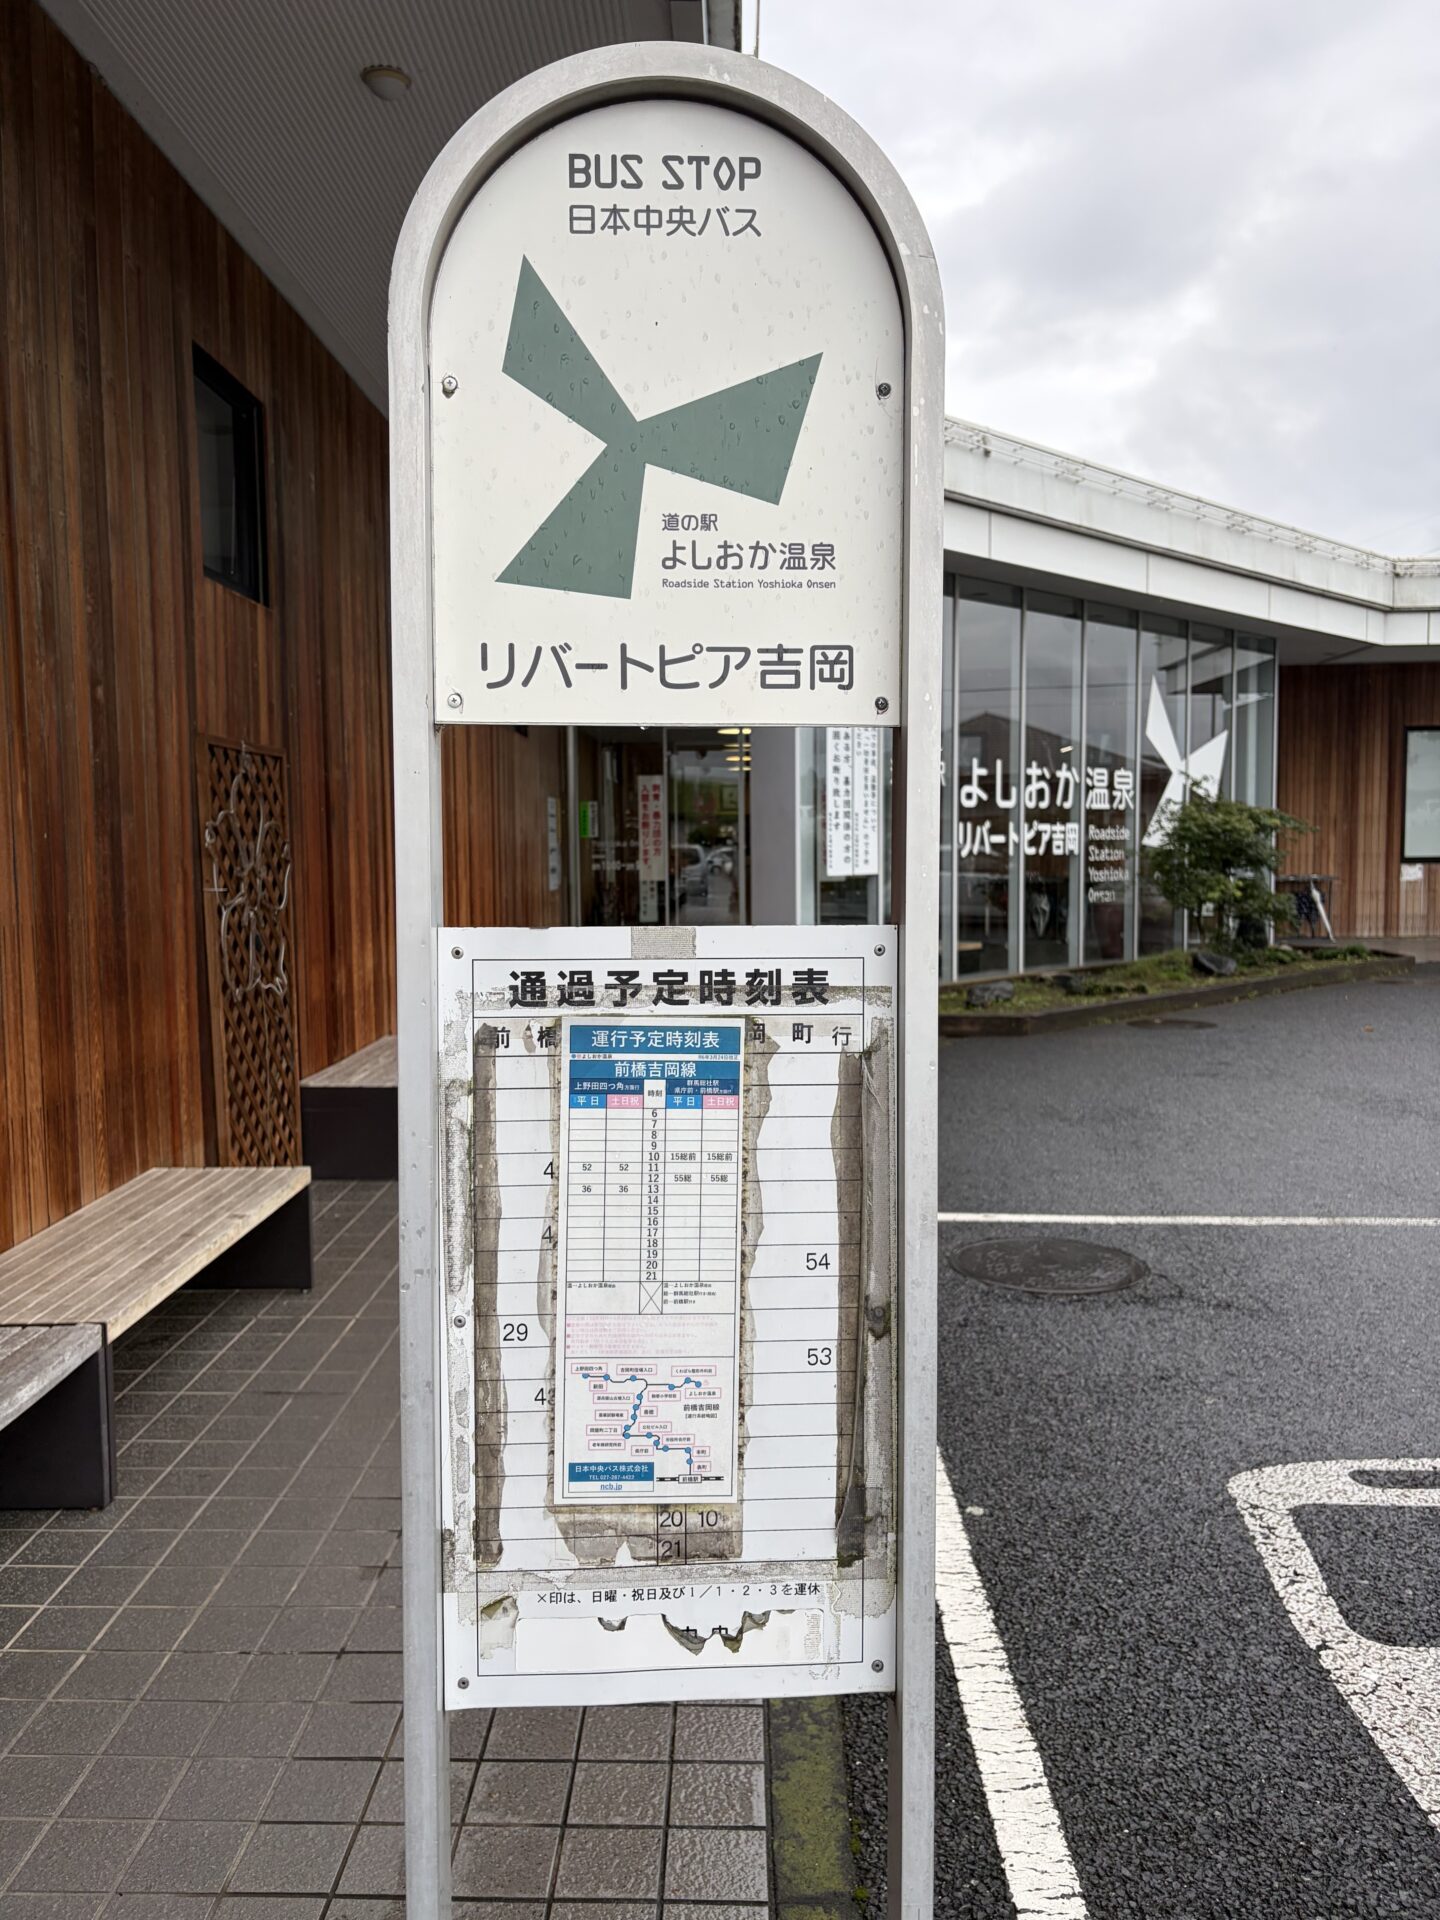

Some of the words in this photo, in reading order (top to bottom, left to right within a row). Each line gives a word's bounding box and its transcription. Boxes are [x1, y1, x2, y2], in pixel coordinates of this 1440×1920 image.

[569, 153, 643, 189] BUS
[662, 155, 762, 192] STOP
[569, 204, 762, 238] 日本中央バス
[661, 513, 719, 532] 道の駅
[661, 541, 837, 571] よしおか温泉
[662, 578, 710, 589] Roadside
[713, 578, 754, 589] Station
[757, 578, 803, 589] Yoshioka
[806, 578, 836, 589] Onsen
[480, 642, 854, 691] リバートピア吉岡
[960, 757, 1135, 811] よしおか温泉
[958, 820, 1080, 858] リバートピア吉岡
[1088, 824, 1131, 842] Roadside
[1088, 845, 1126, 862] Station
[1088, 866, 1130, 882] Yoshioka
[509, 968, 830, 1008] 通過予定時刻表
[592, 1030, 720, 1048] 運行予定時刻表
[615, 1062, 696, 1077] 前橋吉岡線
[577, 1096, 599, 1105] 平日
[611, 1097, 640, 1105] 土日祝
[673, 1097, 695, 1106] 平日
[707, 1097, 734, 1106] 土日祝
[651, 1131, 657, 1139] 8
[651, 1142, 657, 1150] 9
[648, 1174, 659, 1182] 12
[648, 1185, 659, 1193] 13
[648, 1196, 659, 1204] 14
[647, 1207, 658, 1215] 15
[647, 1218, 658, 1226] 16
[646, 1261, 657, 1269] 20
[805, 1252, 831, 1270] 54
[646, 1272, 657, 1280] 21
[502, 1323, 529, 1342] 29
[806, 1348, 832, 1366] 53
[659, 1510, 684, 1528] 20
[699, 1510, 719, 1528] 10
[660, 1541, 682, 1559] 21
